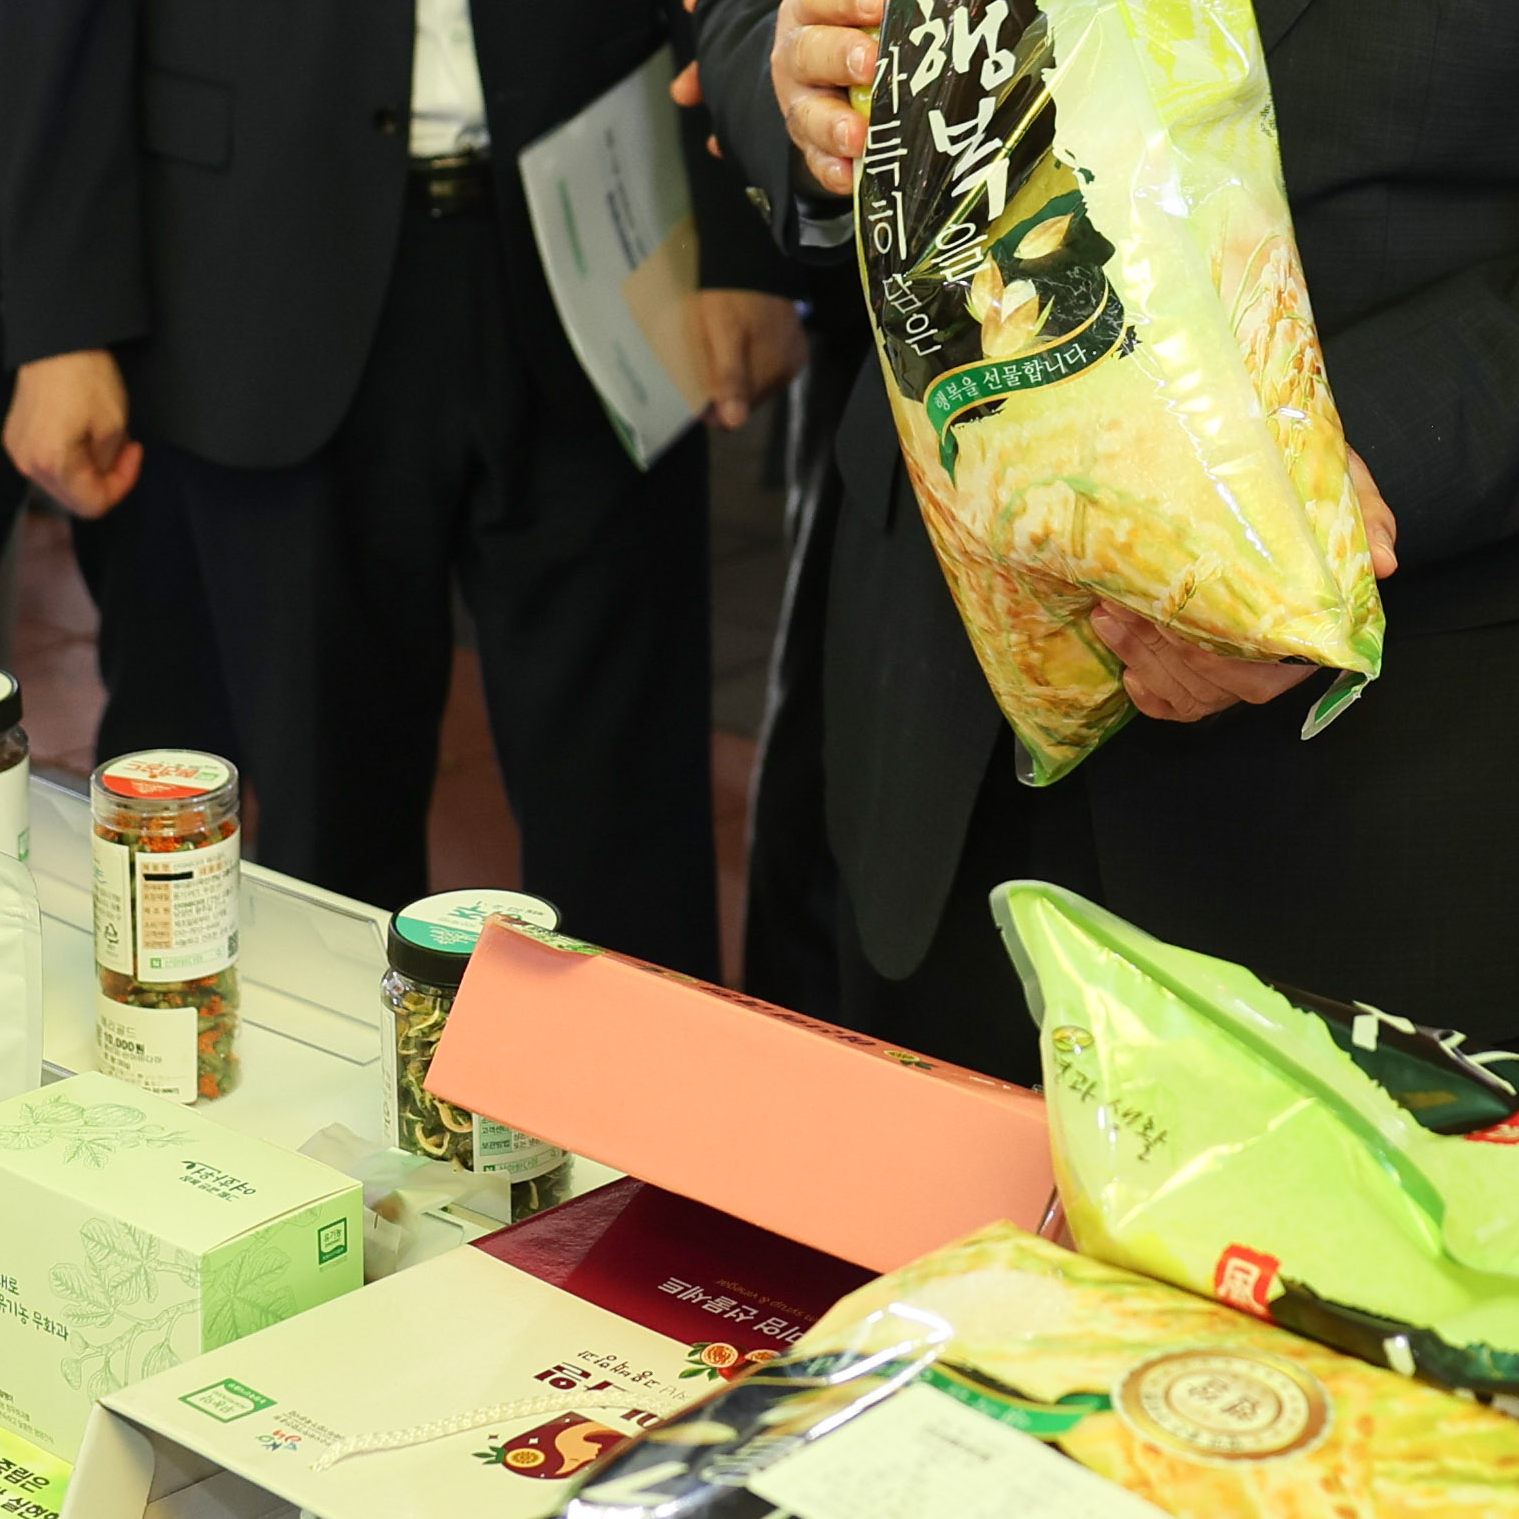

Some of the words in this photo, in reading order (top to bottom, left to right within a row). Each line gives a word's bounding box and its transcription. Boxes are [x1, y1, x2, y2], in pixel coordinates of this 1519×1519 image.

[865, 46, 910, 262] 가득히
[881, 272, 943, 356] 담은
[934, 376, 979, 411] 행복을
[984, 342, 1097, 391] 선물합니다.
[32, 1311, 69, 1341] 무화과
[657, 1276, 760, 1324] 선물세트
[753, 1315, 806, 1346] 미엄
